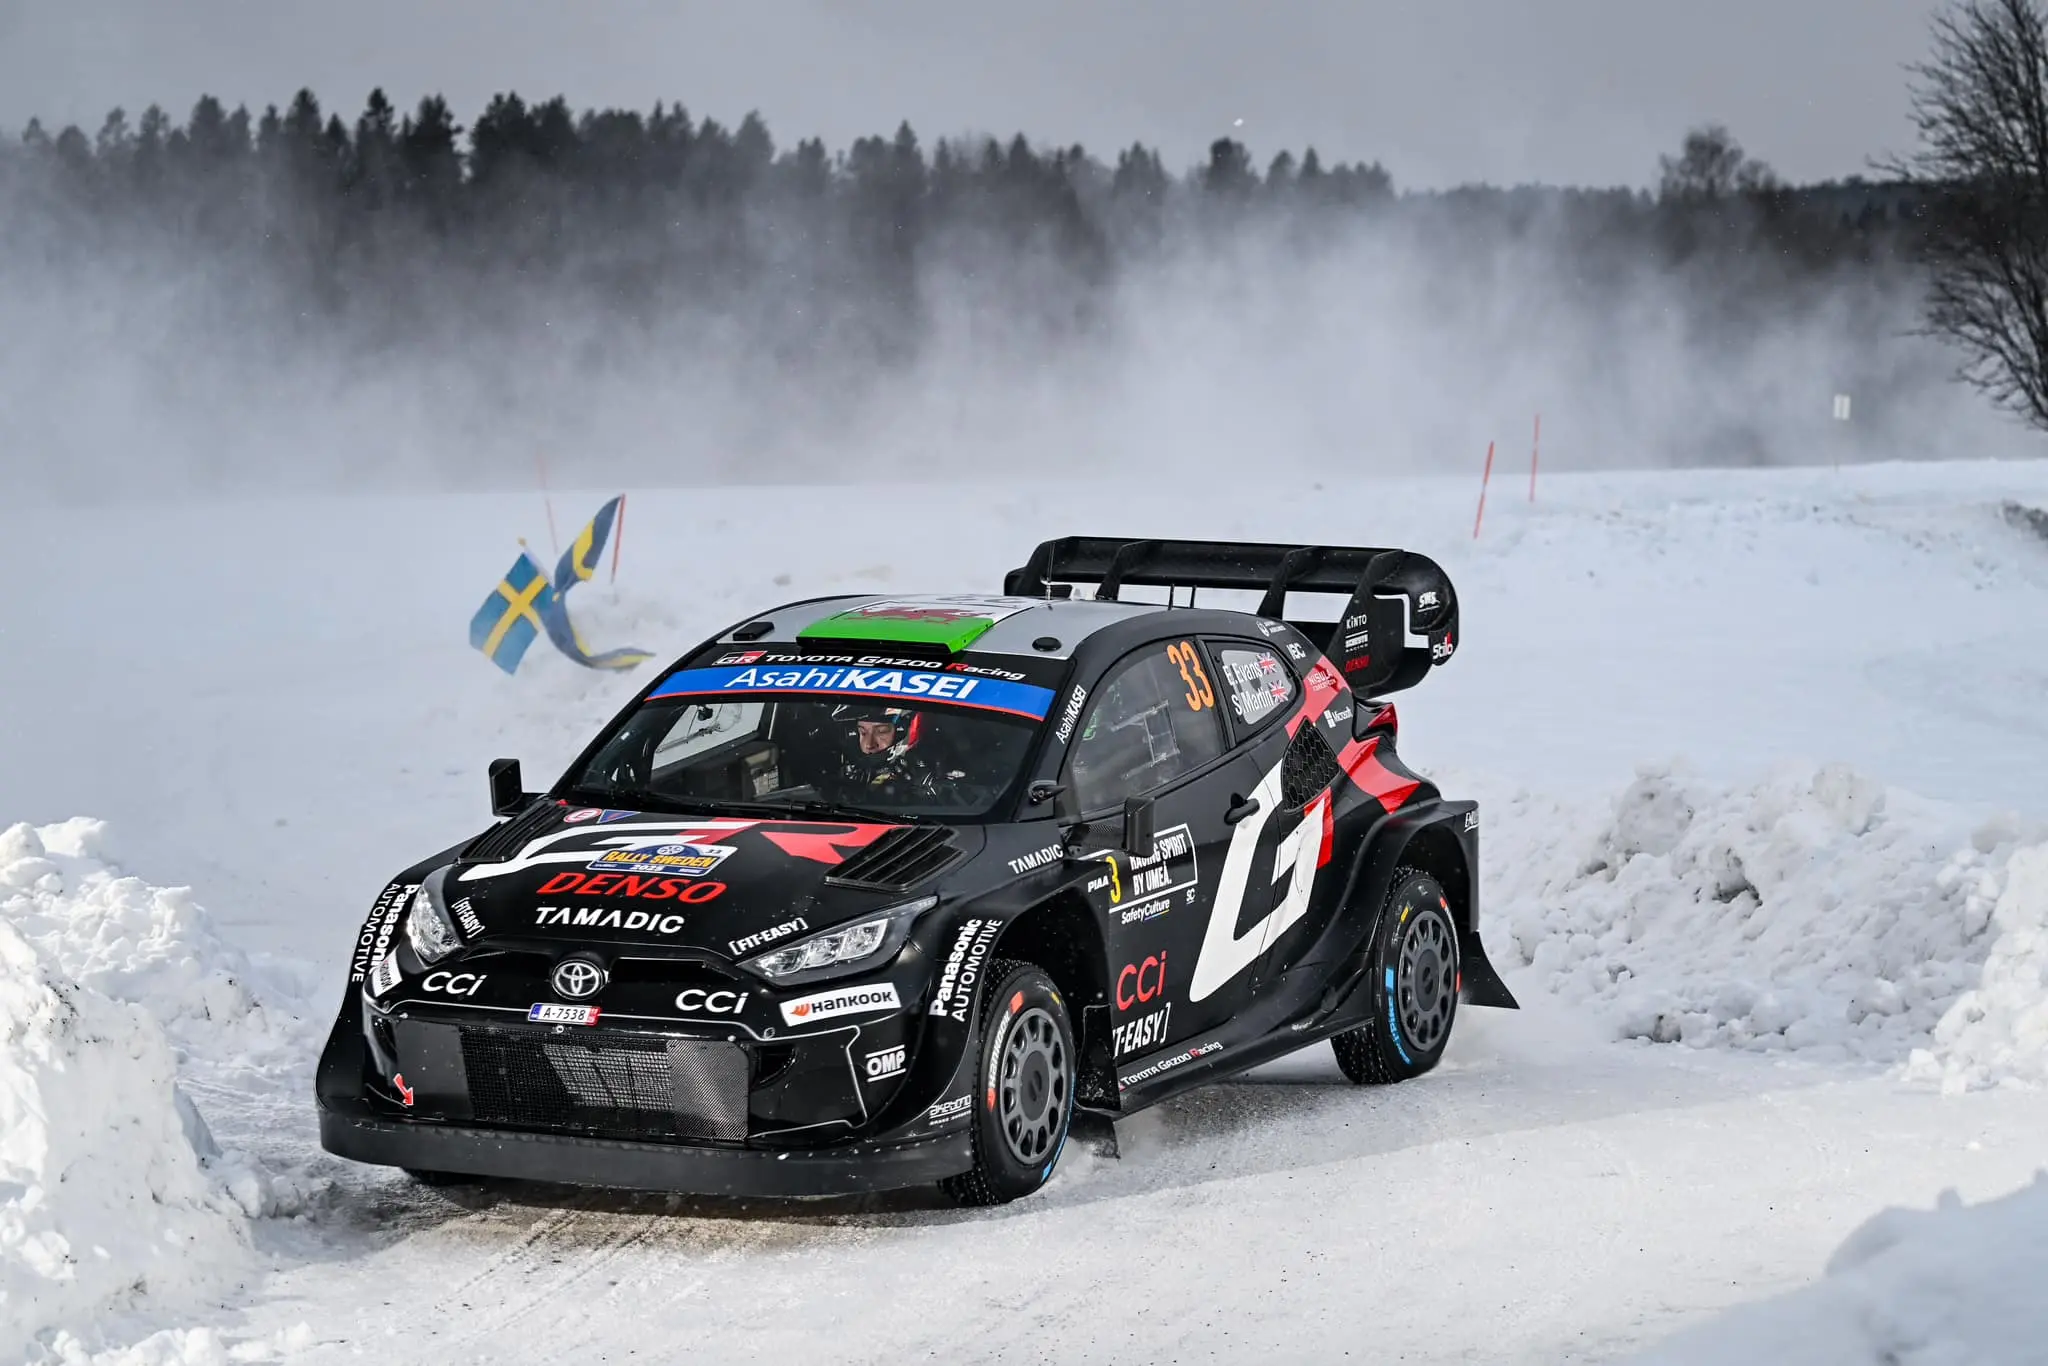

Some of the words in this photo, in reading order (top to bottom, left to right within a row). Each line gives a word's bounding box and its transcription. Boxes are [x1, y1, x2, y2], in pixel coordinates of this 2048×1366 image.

[765, 654, 853, 664] TOYOTA
[854, 656, 943, 669] GAZOO
[945, 663, 1026, 680] Racing
[1167, 641, 1214, 712] 33
[1222, 662, 1263, 686] E.Evans
[724, 669, 980, 700] AsahiKASEI
[1055, 684, 1087, 744] AsahiKASEI
[602, 851, 647, 863] RALLY
[649, 855, 717, 868] SWEDEN
[1008, 844, 1064, 875] TAMADIC
[1159, 833, 1187, 860] SPIRIT
[536, 872, 727, 904] DENSO
[1087, 876, 1109, 893] PIAA
[1106, 856, 1121, 904] 3
[1132, 873, 1146, 896] BY
[535, 906, 684, 934] TAMADIC
[1121, 899, 1171, 925] SafetyCulture
[351, 883, 401, 982] AUTOMOTIVE
[929, 918, 982, 1017] Panasonic
[951, 919, 1002, 1023] AUTOMOTIVE
[543, 1007, 586, 1020] A-7538
[867, 1050, 905, 1076] OMP
[1120, 1067, 1160, 1086] TOYOTA
[1157, 1053, 1192, 1071] GAZOO
[1188, 1041, 1224, 1058] Racing
